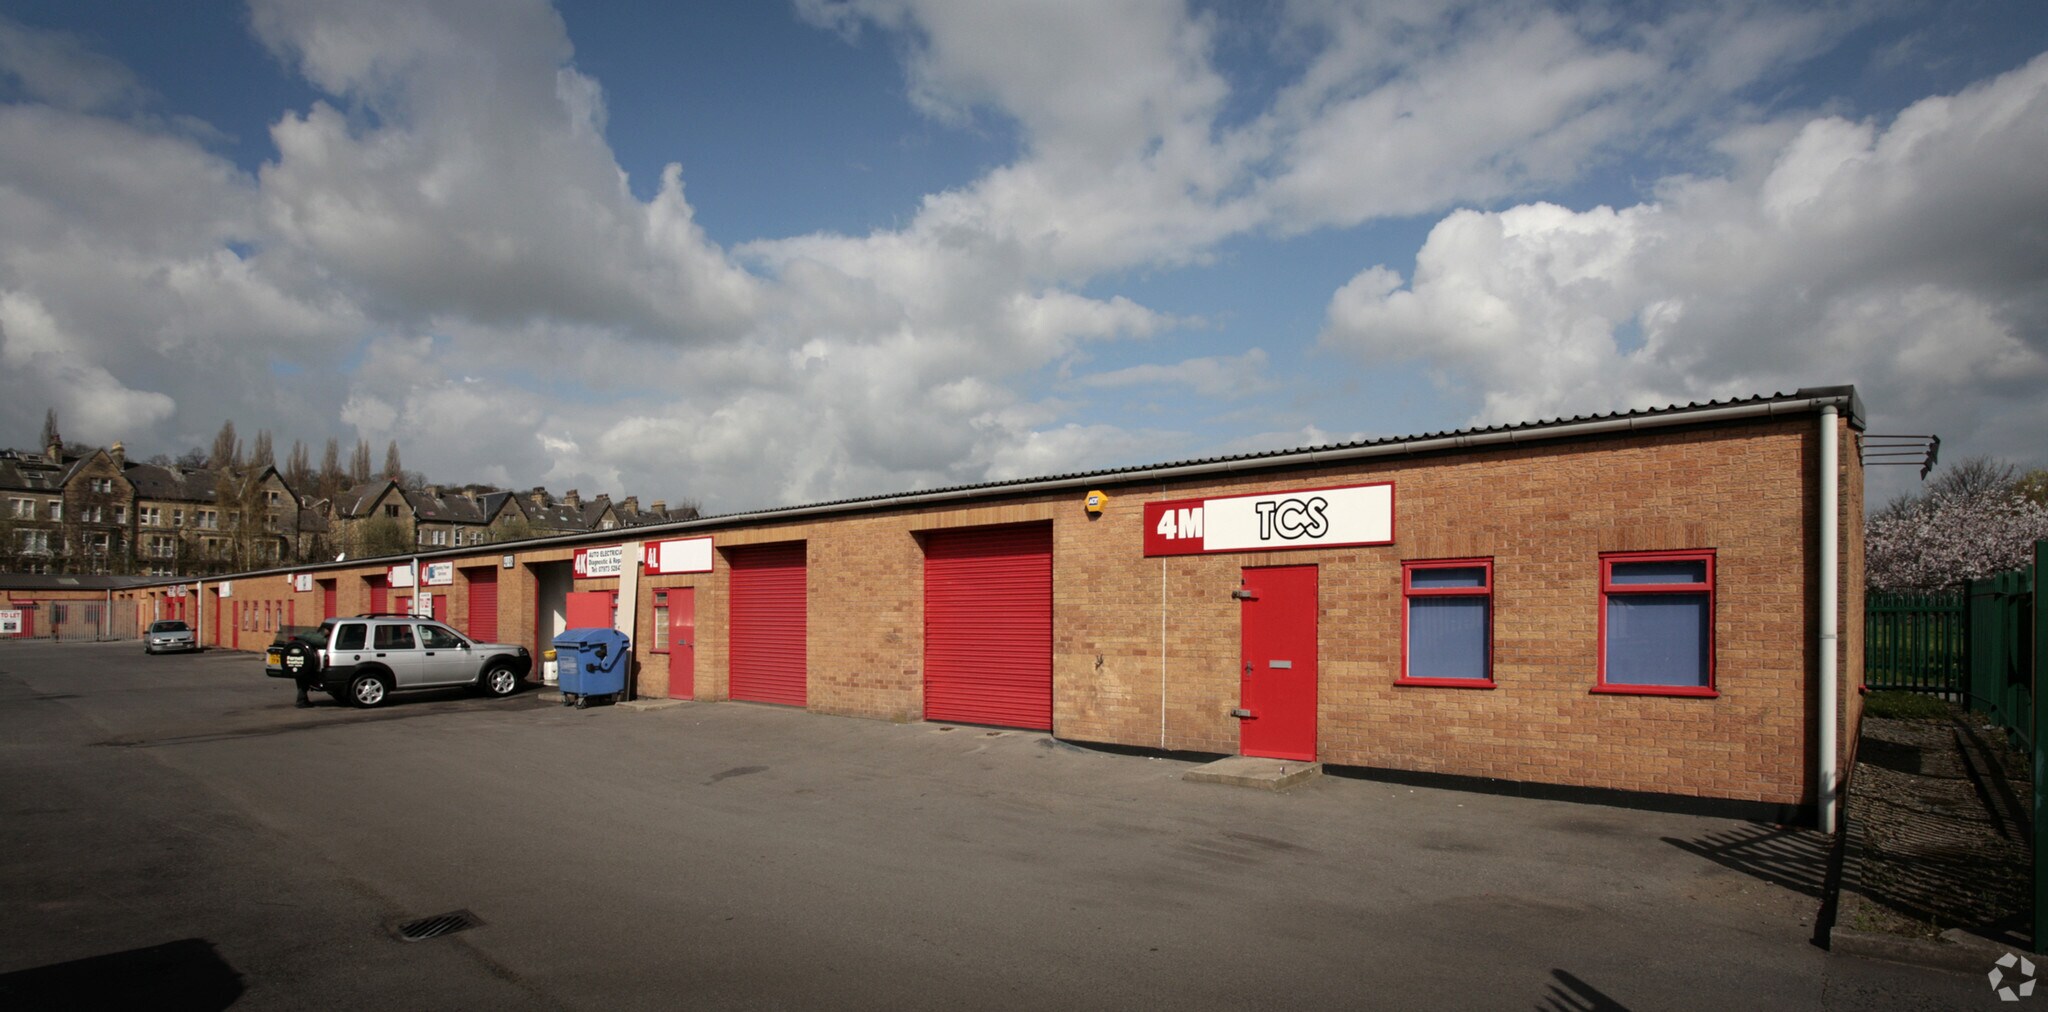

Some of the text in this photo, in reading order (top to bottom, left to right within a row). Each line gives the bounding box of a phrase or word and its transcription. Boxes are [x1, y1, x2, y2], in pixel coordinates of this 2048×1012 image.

[1157, 507, 1203, 540] 4M
[1256, 497, 1328, 540] TCS
[575, 553, 587, 574] 4K
[589, 559, 608, 567] Diagnostic
[647, 547, 659, 568] 4L
